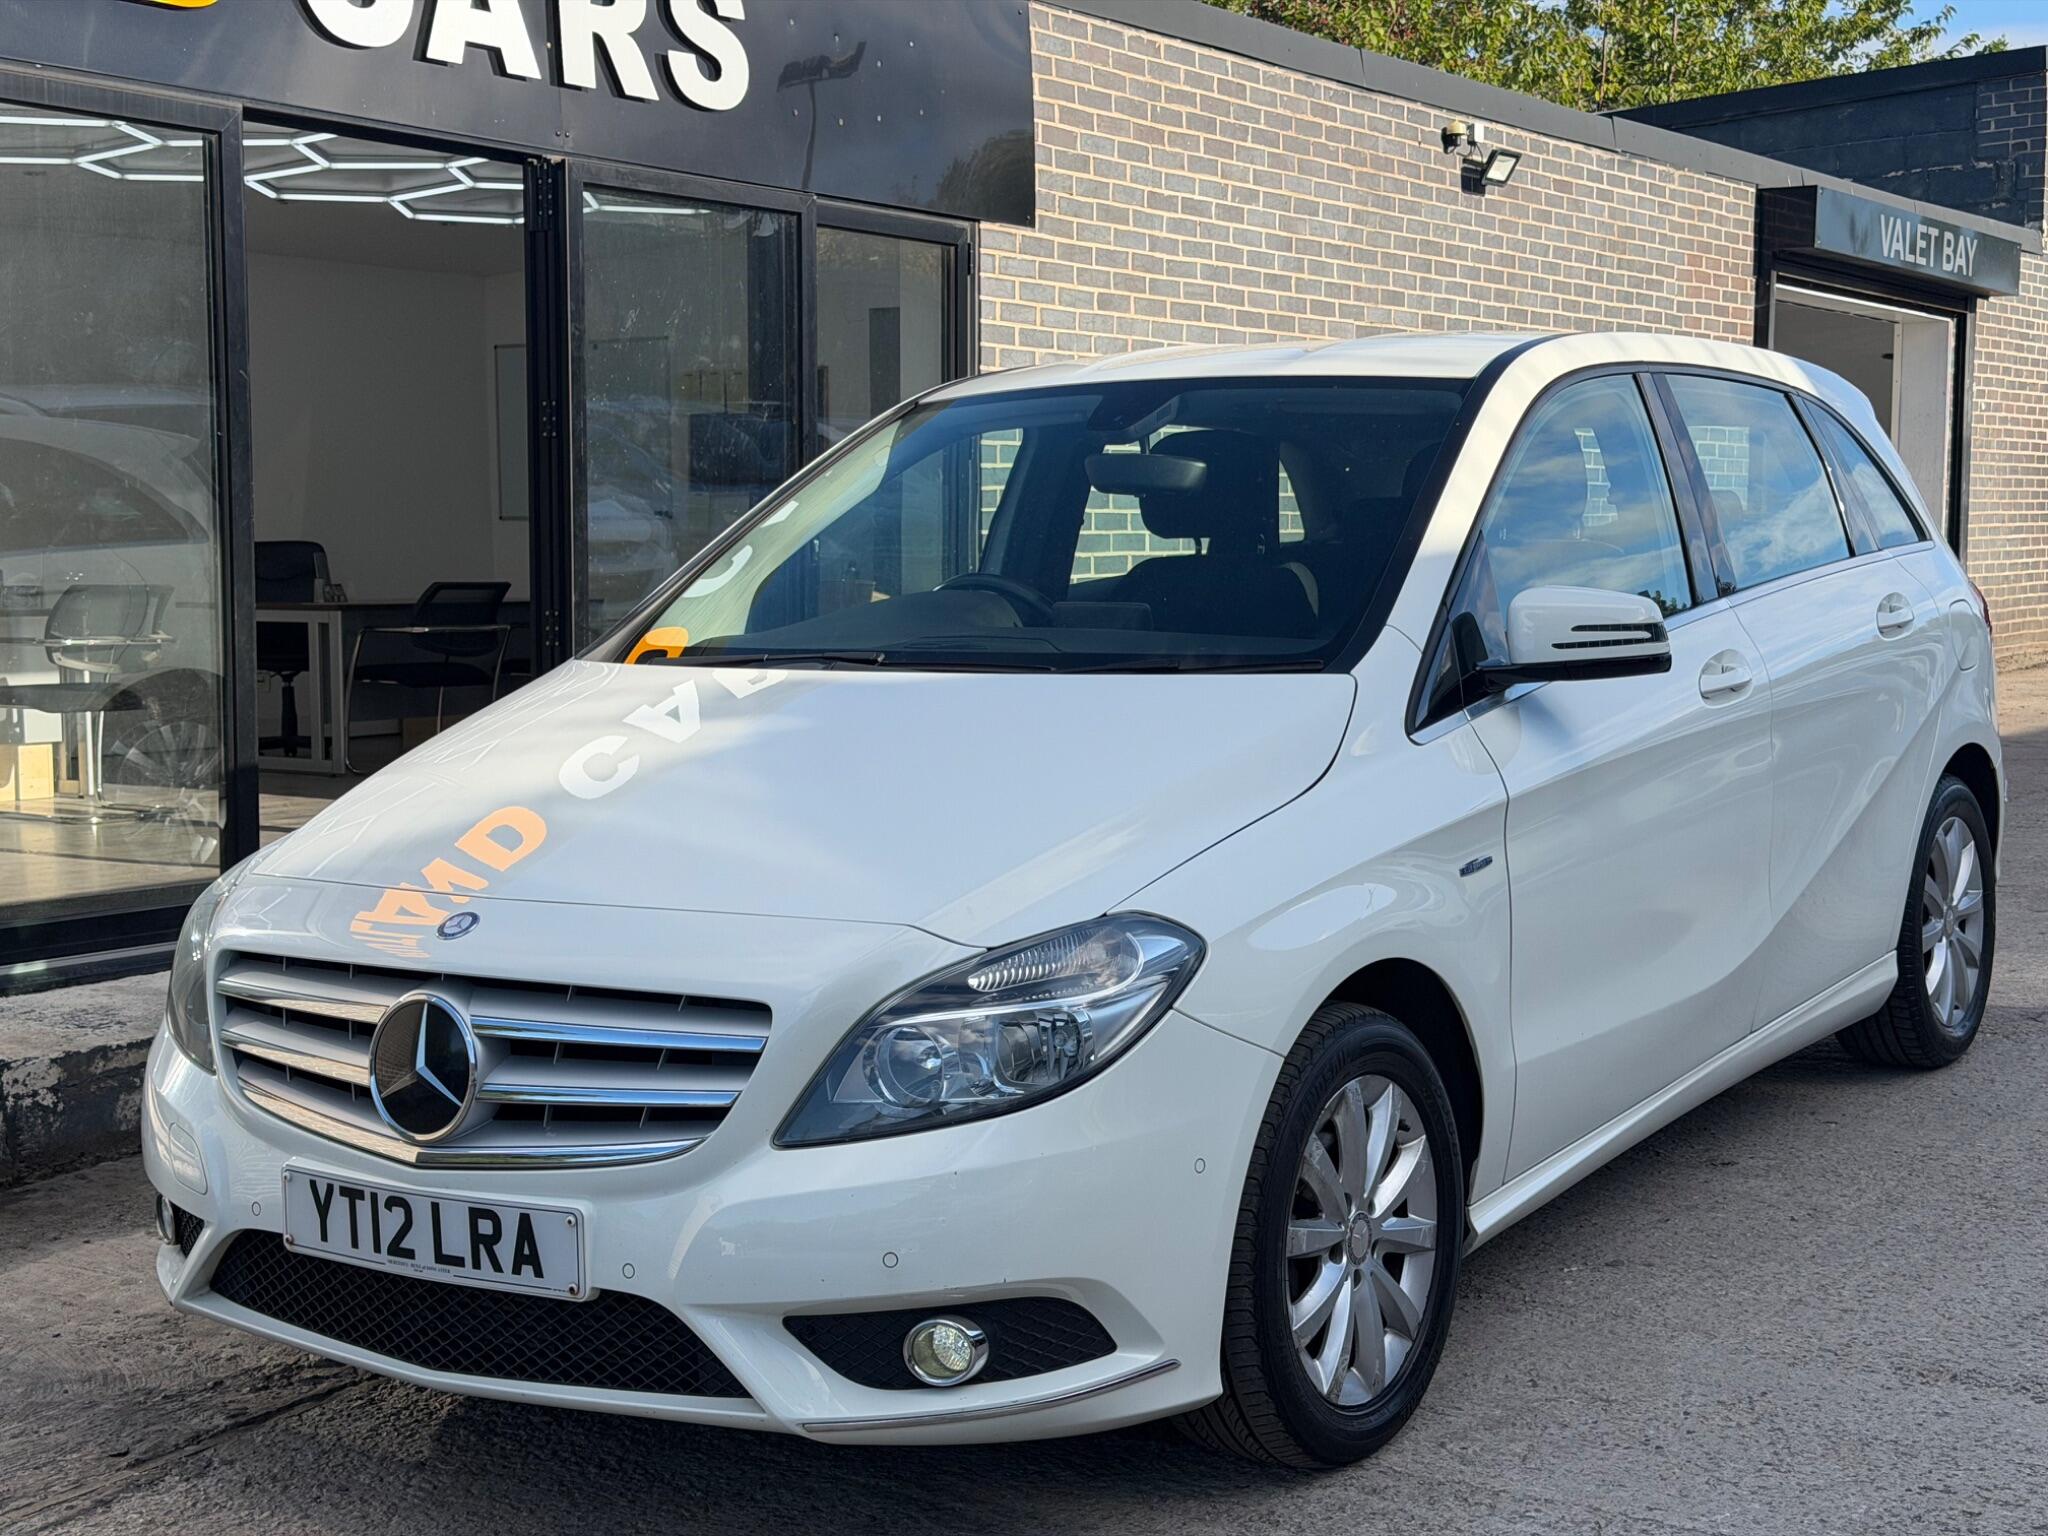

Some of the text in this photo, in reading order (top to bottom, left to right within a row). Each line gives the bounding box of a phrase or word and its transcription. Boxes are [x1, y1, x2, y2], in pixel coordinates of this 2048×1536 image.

[1880, 213, 1978, 277] VALET BAY
[309, 1179, 545, 1279] YT12 LRA
